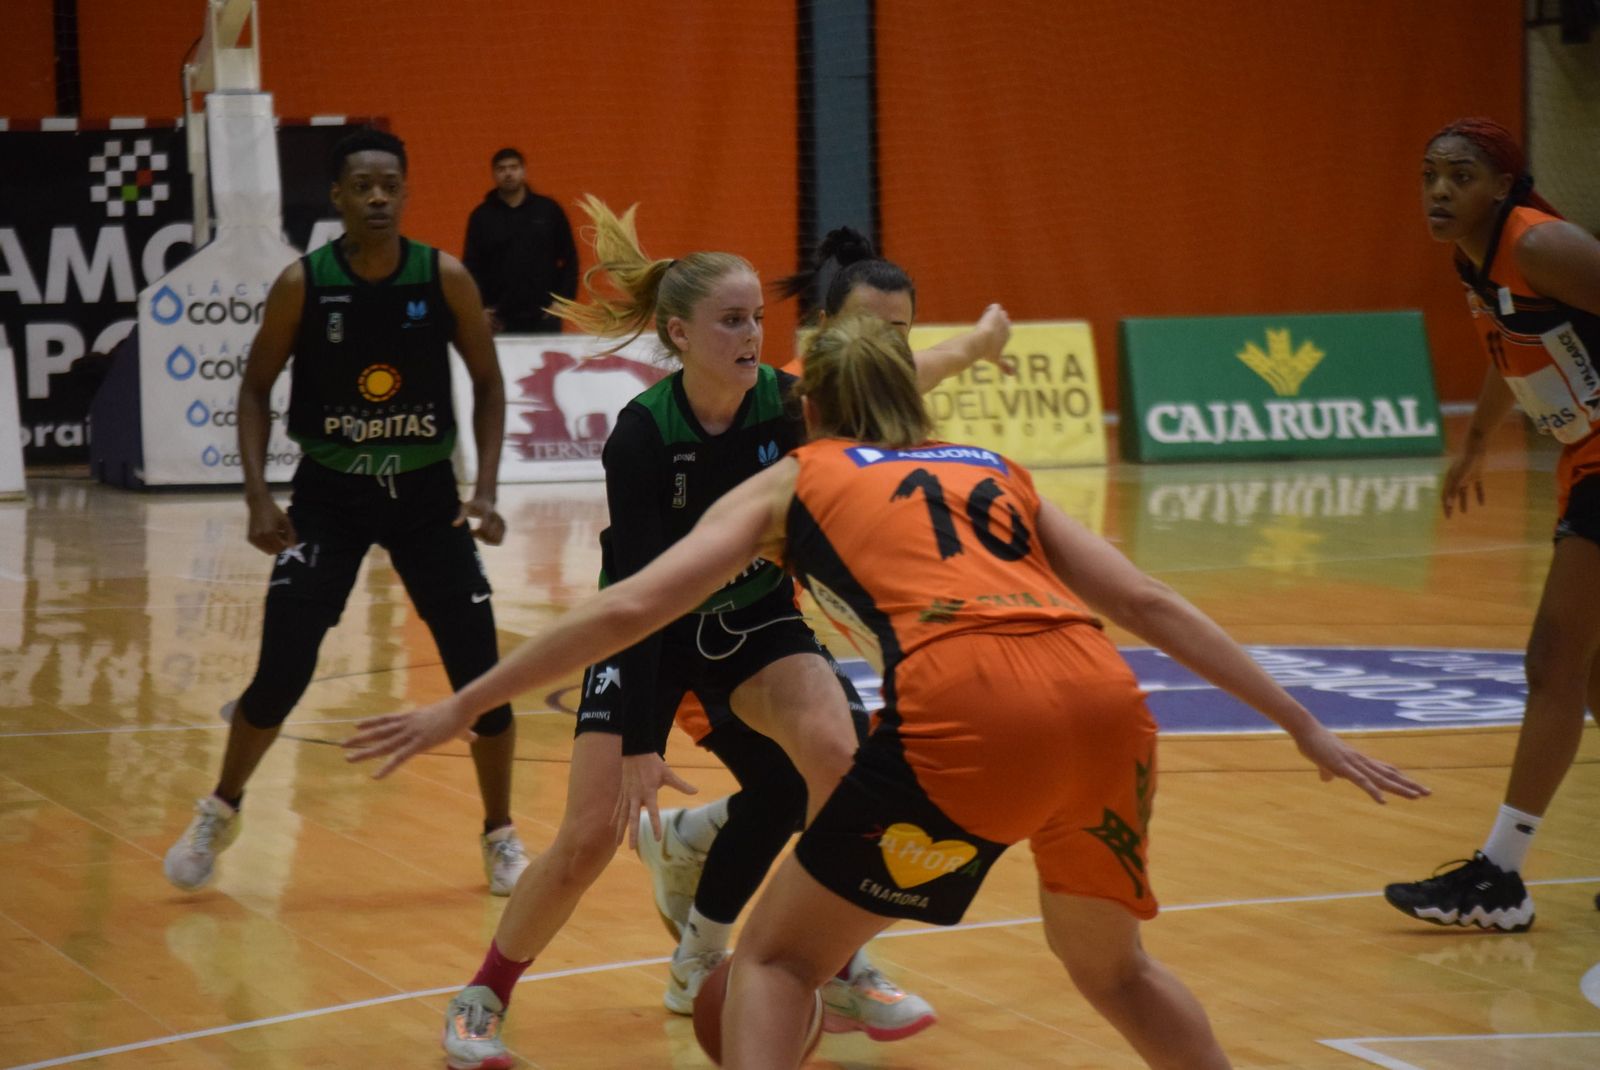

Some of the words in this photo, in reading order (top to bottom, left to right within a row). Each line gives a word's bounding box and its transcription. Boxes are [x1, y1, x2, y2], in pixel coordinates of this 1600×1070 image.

[187, 297, 265, 325] cobr
[957, 353, 1086, 384] ERRA
[323, 414, 438, 443] PROBITAS
[1146, 404, 1266, 445] CAJA
[1266, 396, 1437, 440] RURAL
[1539, 408, 1575, 429] tas
[528, 442, 602, 459] TERNE
[858, 877, 931, 909] ENAMORA
